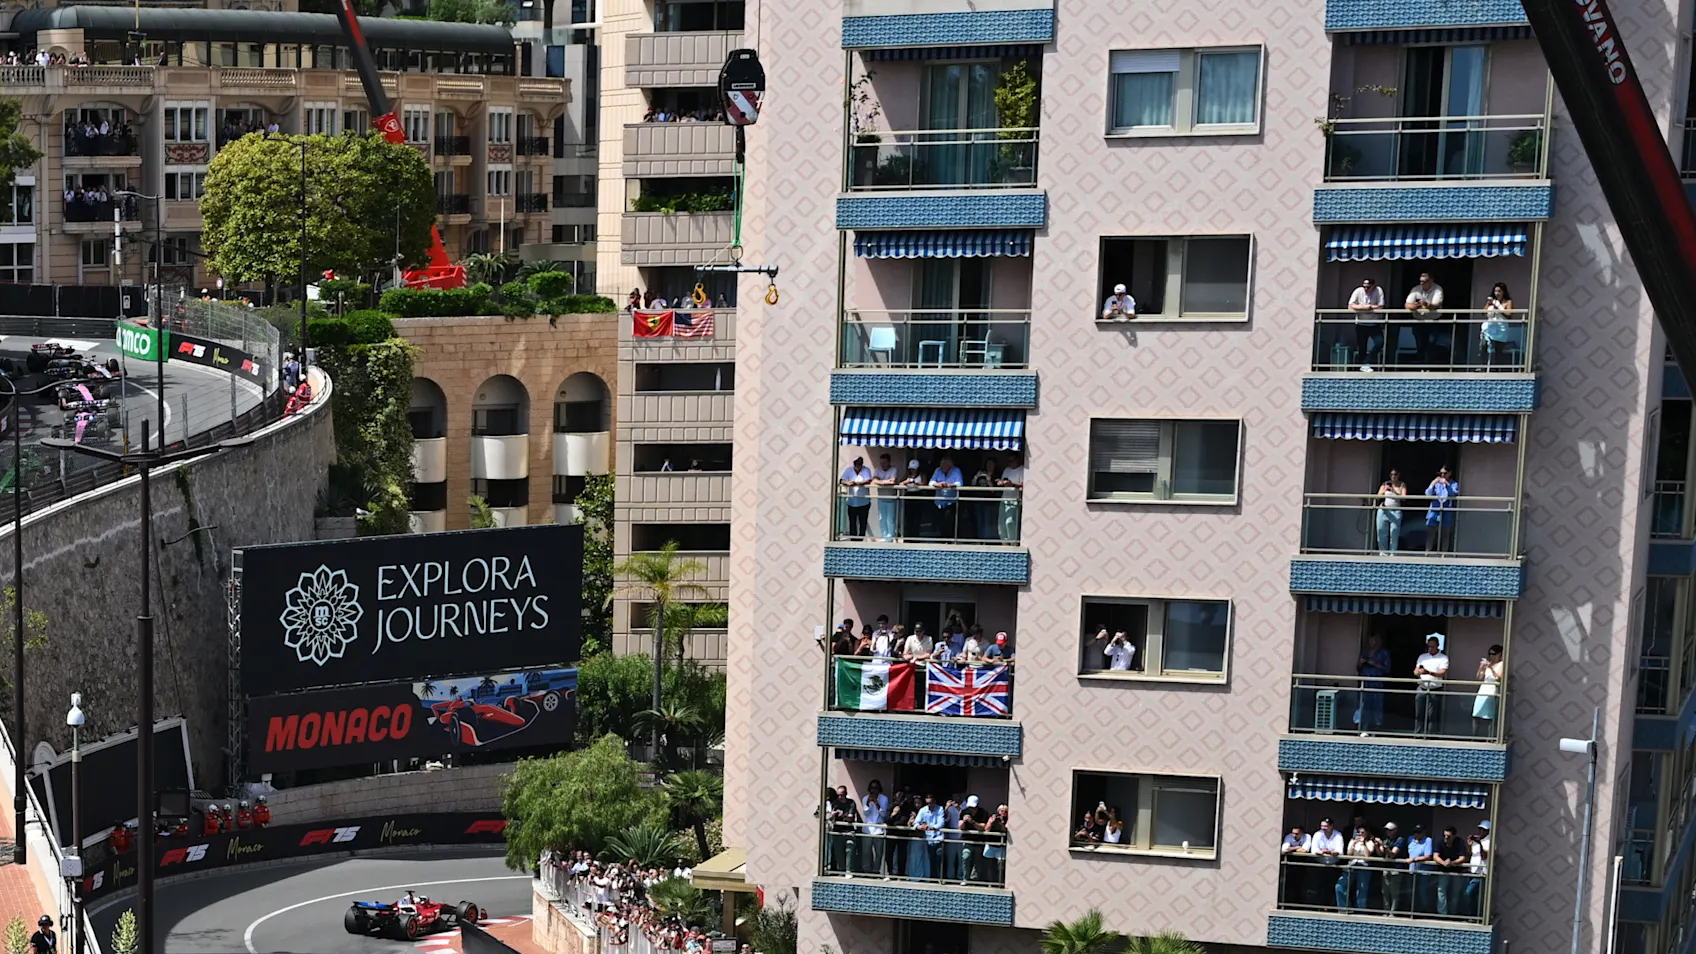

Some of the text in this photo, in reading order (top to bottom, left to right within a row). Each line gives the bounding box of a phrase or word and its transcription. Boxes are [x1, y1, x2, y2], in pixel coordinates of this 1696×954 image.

[377, 555, 537, 601] EXPLORA
[372, 594, 549, 655] JOURNEYS
[265, 704, 412, 752] MONACO
[226, 836, 264, 861] Monaco
[381, 821, 422, 842] Monaco
